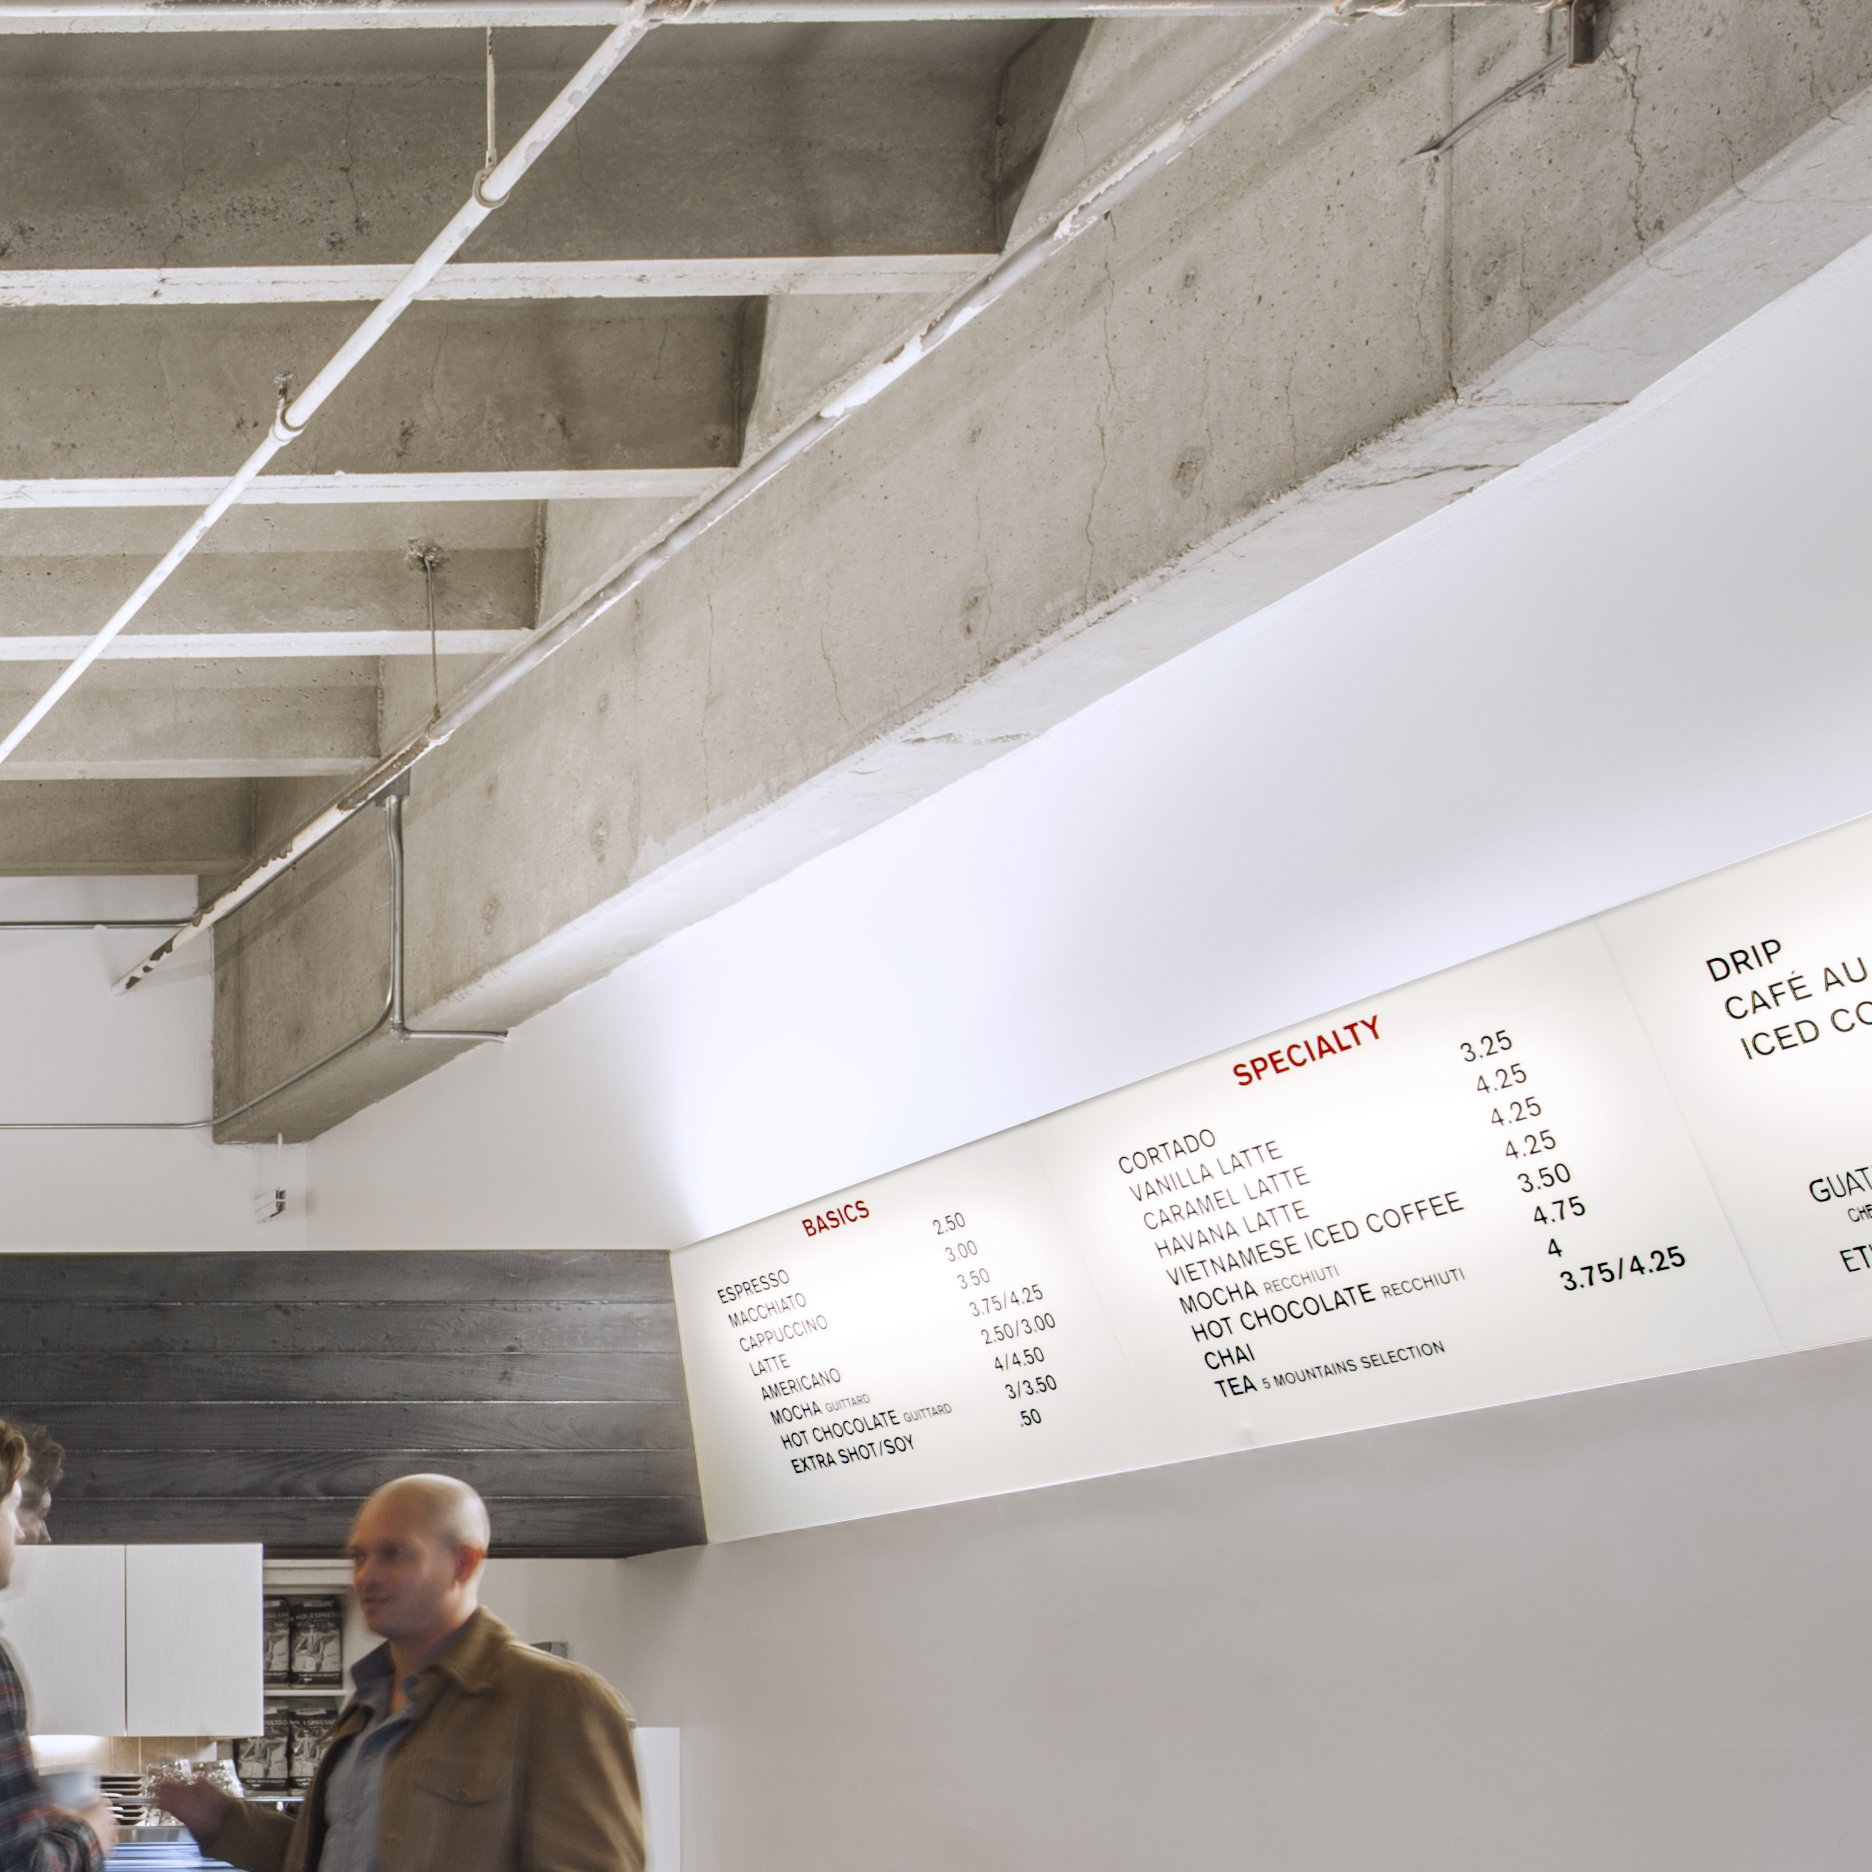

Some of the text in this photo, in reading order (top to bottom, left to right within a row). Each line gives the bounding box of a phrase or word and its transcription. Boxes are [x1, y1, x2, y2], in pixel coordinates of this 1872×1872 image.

[1705, 939, 1781, 982] DRIP
[1725, 957, 1868, 1020] CAFÉ AU
[1233, 1014, 1380, 1086] SPECIALTY
[1460, 1029, 1512, 1062] 3.25
[1740, 1019, 1820, 1060] ICED
[1477, 1063, 1527, 1093] 4.25
[1491, 1096, 1542, 1126] 4.25
[1118, 1129, 1215, 1174] CORTADO
[1505, 1129, 1556, 1159] 4.25
[1129, 1140, 1283, 1202] VANILLA LATTE
[1517, 1163, 1571, 1193] 3.50
[1144, 1166, 1311, 1230] CARAMEL LATTE
[1534, 1195, 1586, 1225] 4.75
[801, 1200, 870, 1237] BASICS
[933, 1212, 965, 1235] 2.50
[1155, 1200, 1310, 1258] HAVANA LATTE
[945, 1240, 978, 1262] 3.00
[1166, 1191, 1465, 1286] VIETNAMESE ICED COFFEE
[1548, 1238, 1563, 1257] 4
[957, 1268, 990, 1289] 3.50
[1560, 1245, 1686, 1291] 3.75/4.25
[717, 1269, 789, 1304] ESPRESSO
[969, 1284, 1043, 1317] 3.75/4.25
[1179, 1265, 1339, 1314] MOCHA RECCHIUTI
[728, 1293, 806, 1328] MACCHIATO
[1191, 1268, 1465, 1342] HOT CHOCOLATE RECCHIUTI
[739, 1315, 828, 1352] CAPPUCCINO
[981, 1313, 1056, 1344] 2.50/3.00
[749, 1354, 790, 1376] LATTE
[995, 1347, 1045, 1371] 4/4.50
[1204, 1343, 1255, 1370] CHAI
[1214, 1341, 1445, 1398] TEA 5 MOUNTAINS SELECTION
[761, 1368, 841, 1401] AMERICANO
[1005, 1375, 1057, 1399] 3/3.50
[770, 1394, 870, 1425] MOCHA GUITTARD
[780, 1404, 952, 1449] HOT CHOCOLATE GUITTARD
[1020, 1408, 1042, 1427] .50
[791, 1434, 914, 1474] EXTRA SHOT/SOY
